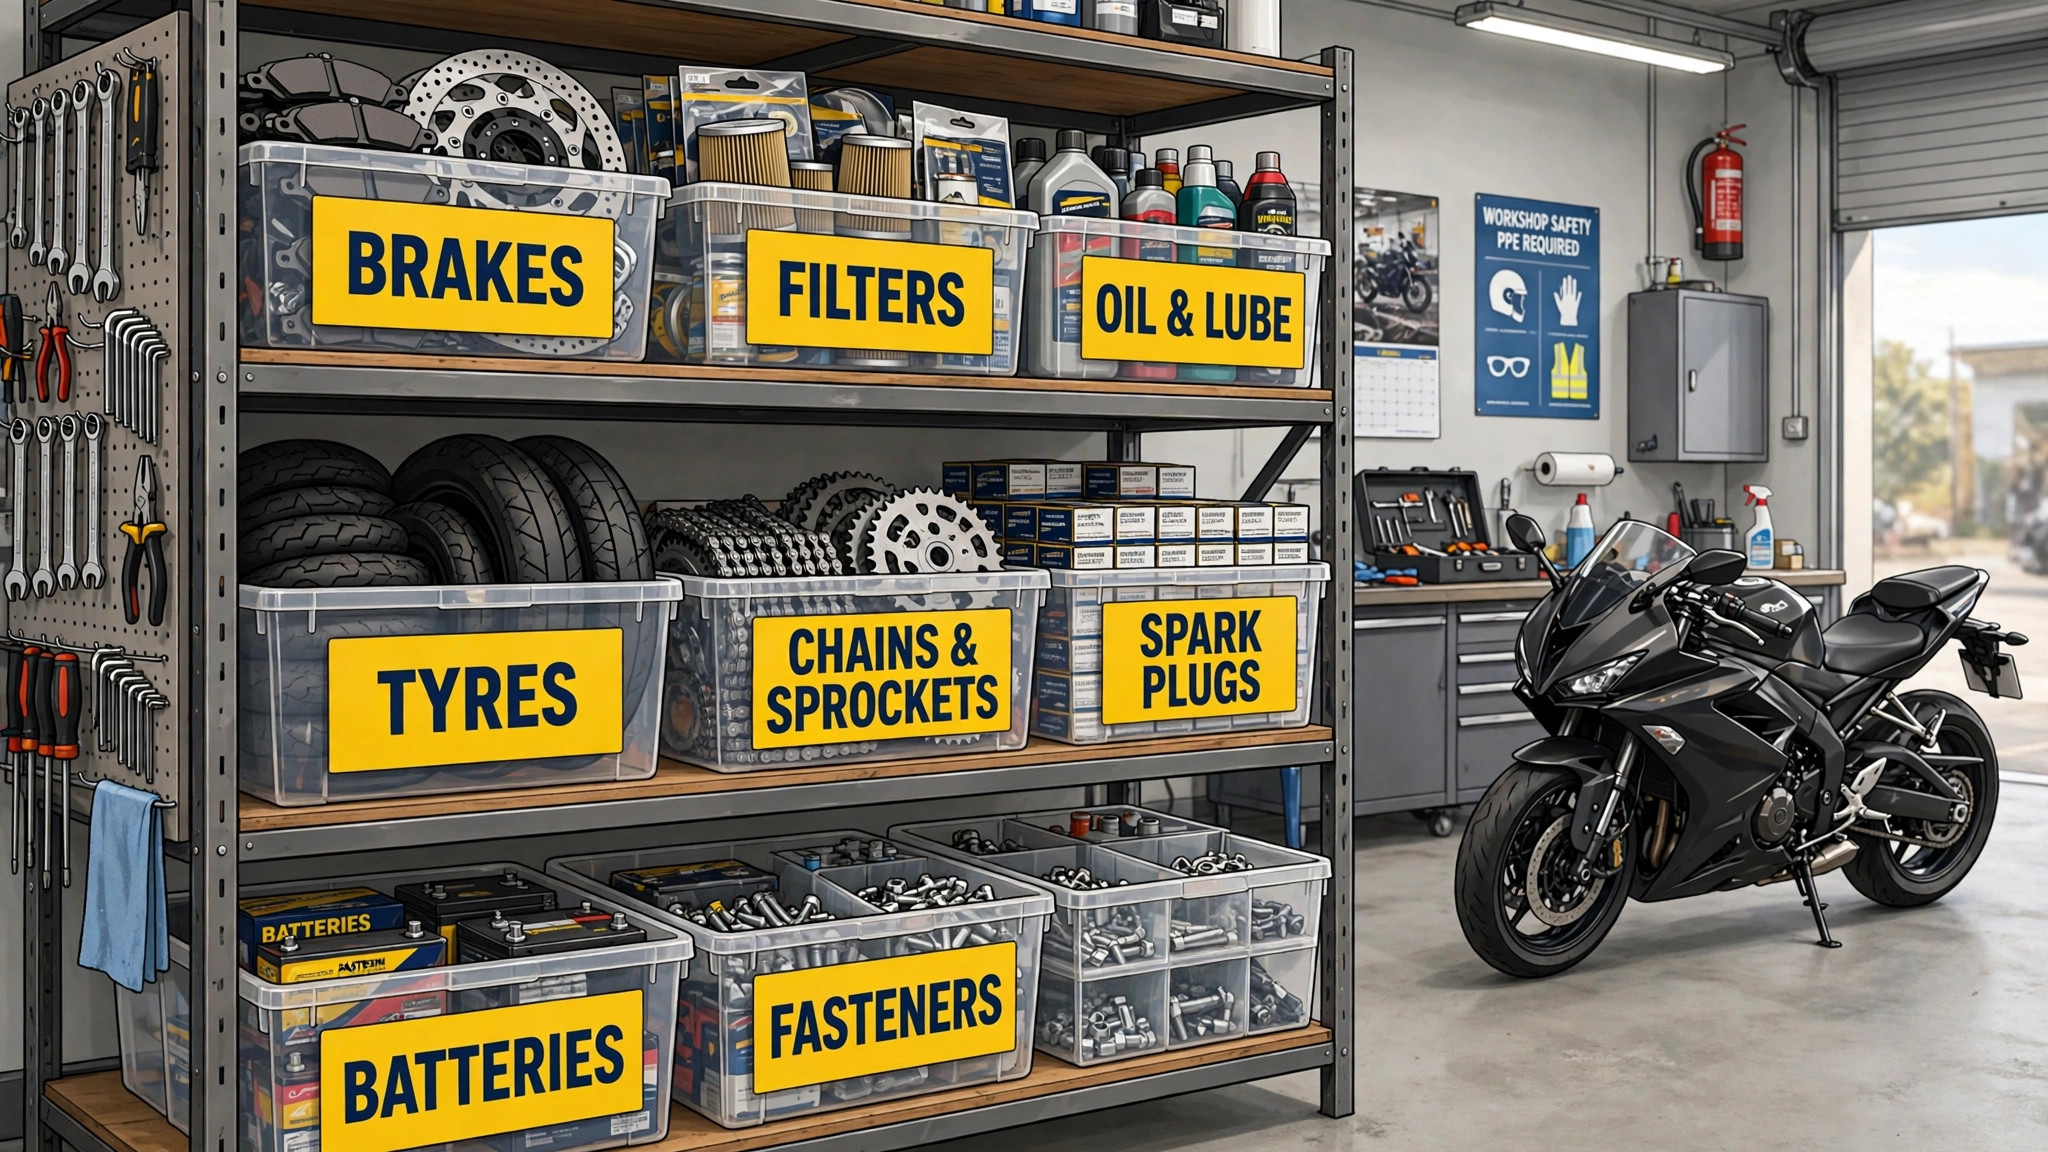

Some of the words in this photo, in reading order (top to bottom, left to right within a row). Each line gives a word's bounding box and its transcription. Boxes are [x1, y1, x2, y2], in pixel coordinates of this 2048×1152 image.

[1482, 206, 1549, 231] WORKSHOP
[1550, 214, 1592, 236] SAFETY
[1497, 231, 1520, 251] PPE
[1522, 234, 1580, 257] REQUIRED
[348, 230, 584, 308] BRAKES
[779, 259, 965, 328] FILTERS
[1096, 283, 1157, 335] OIL
[1166, 288, 1195, 337] &
[1205, 291, 1292, 343] LUBE
[788, 622, 939, 676] CHAINS
[950, 622, 979, 667] &
[1140, 609, 1263, 658] SPARK
[377, 661, 578, 736] TYRES
[766, 674, 999, 735] SPROCKETS
[1143, 658, 1261, 710] PLUGS
[262, 913, 371, 943] BATTERIES
[771, 973, 1003, 1060] FASTENERS
[344, 1024, 625, 1125] BATTERIES
